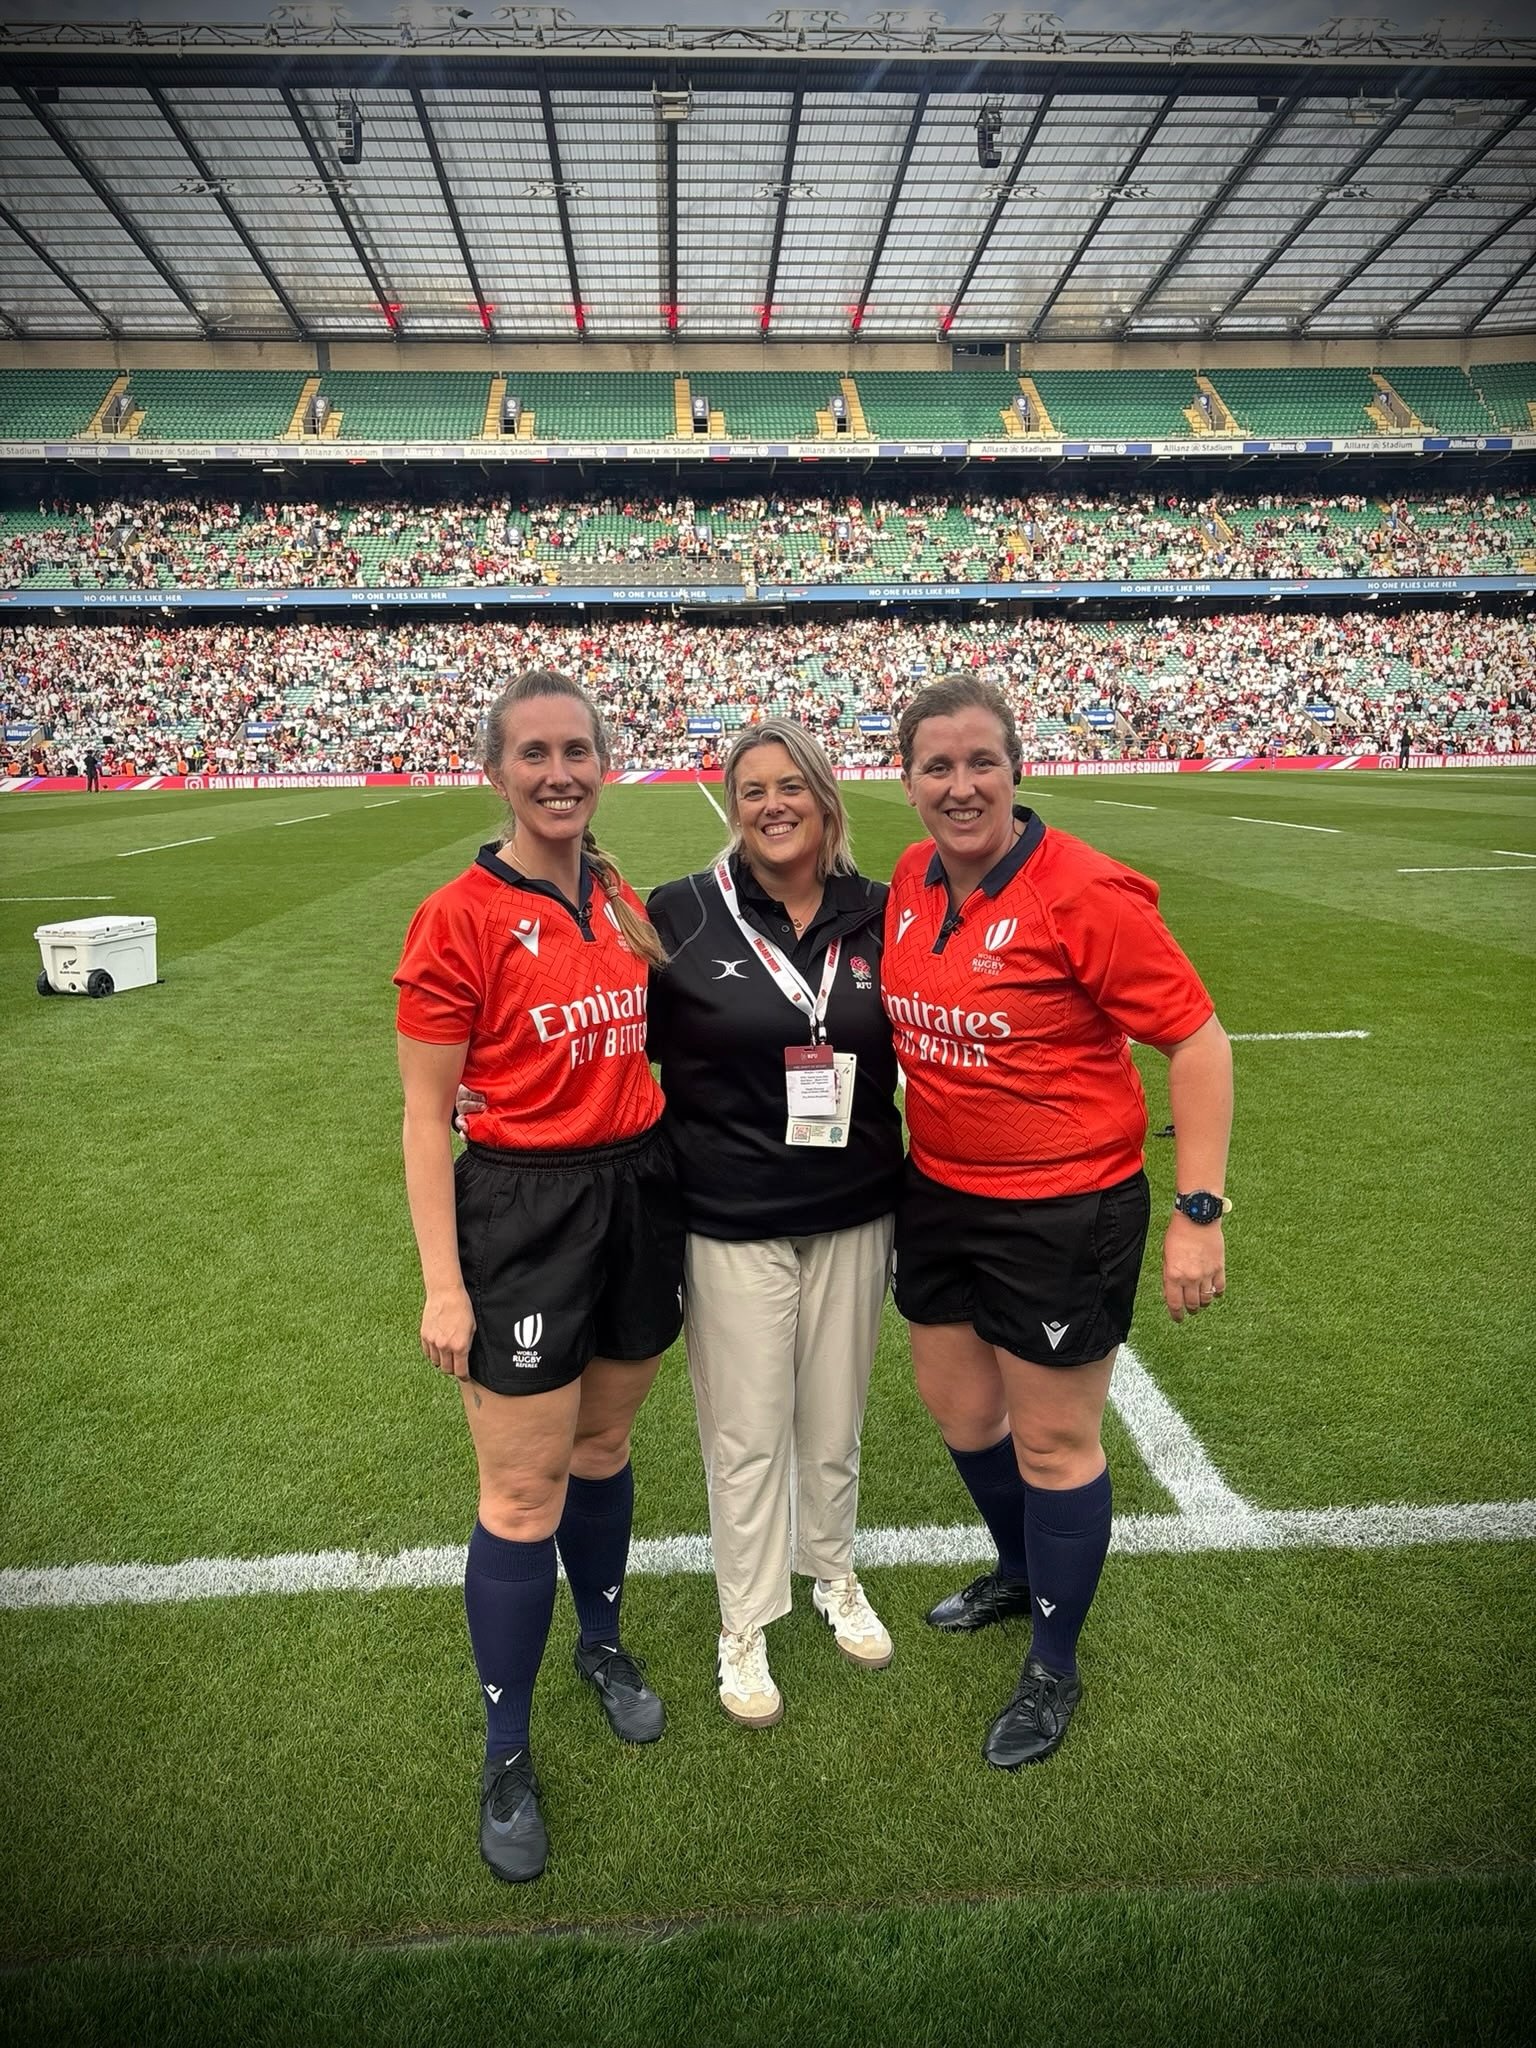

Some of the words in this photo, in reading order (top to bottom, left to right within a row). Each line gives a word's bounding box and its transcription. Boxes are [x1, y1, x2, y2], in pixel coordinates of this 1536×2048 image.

[1163, 444, 1190, 452] Allianz
[1202, 444, 1233, 452] Stadium
[1268, 443, 1295, 451] Allianz
[1344, 442, 1370, 450] Allianz
[1382, 441, 1413, 449] Stadium
[1448, 440, 1476, 449] Allianz
[6, 447, 40, 455] Stadium
[135, 447, 163, 455] Allianz
[178, 447, 211, 455] Stadium
[304, 447, 332, 456] Allianz
[345, 447, 378, 456] Stadium
[510, 448, 542, 456] Stadium
[633, 447, 661, 455] Allianz
[673, 447, 705, 455] Stadium
[799, 446, 826, 454] Allianz
[838, 446, 870, 454] Stadium
[981, 445, 1009, 454] Allianz
[1021, 445, 1052, 454] Stadium
[1088, 445, 1115, 454] Allianz
[971, 957, 1005, 971] RUGBY
[570, 1032, 598, 1070] FLY
[919, 1034, 989, 1067] BETTER
[512, 1355, 542, 1363] RUGBY
